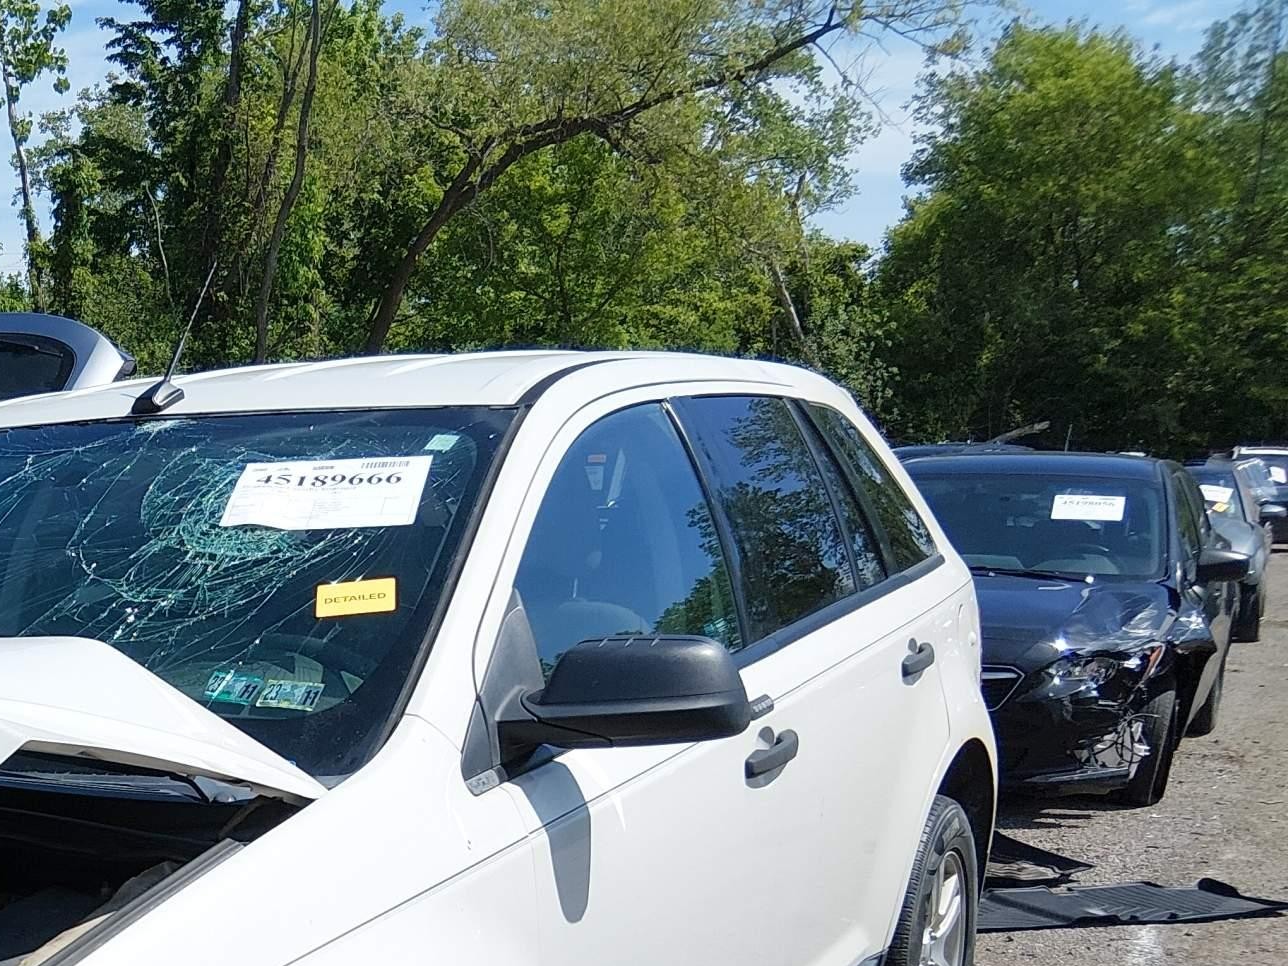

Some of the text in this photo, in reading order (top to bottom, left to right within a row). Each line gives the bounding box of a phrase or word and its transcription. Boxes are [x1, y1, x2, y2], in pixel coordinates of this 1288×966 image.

[256, 471, 403, 488] 45189666
[324, 592, 387, 605] DETAILED
[263, 683, 283, 701] 23
